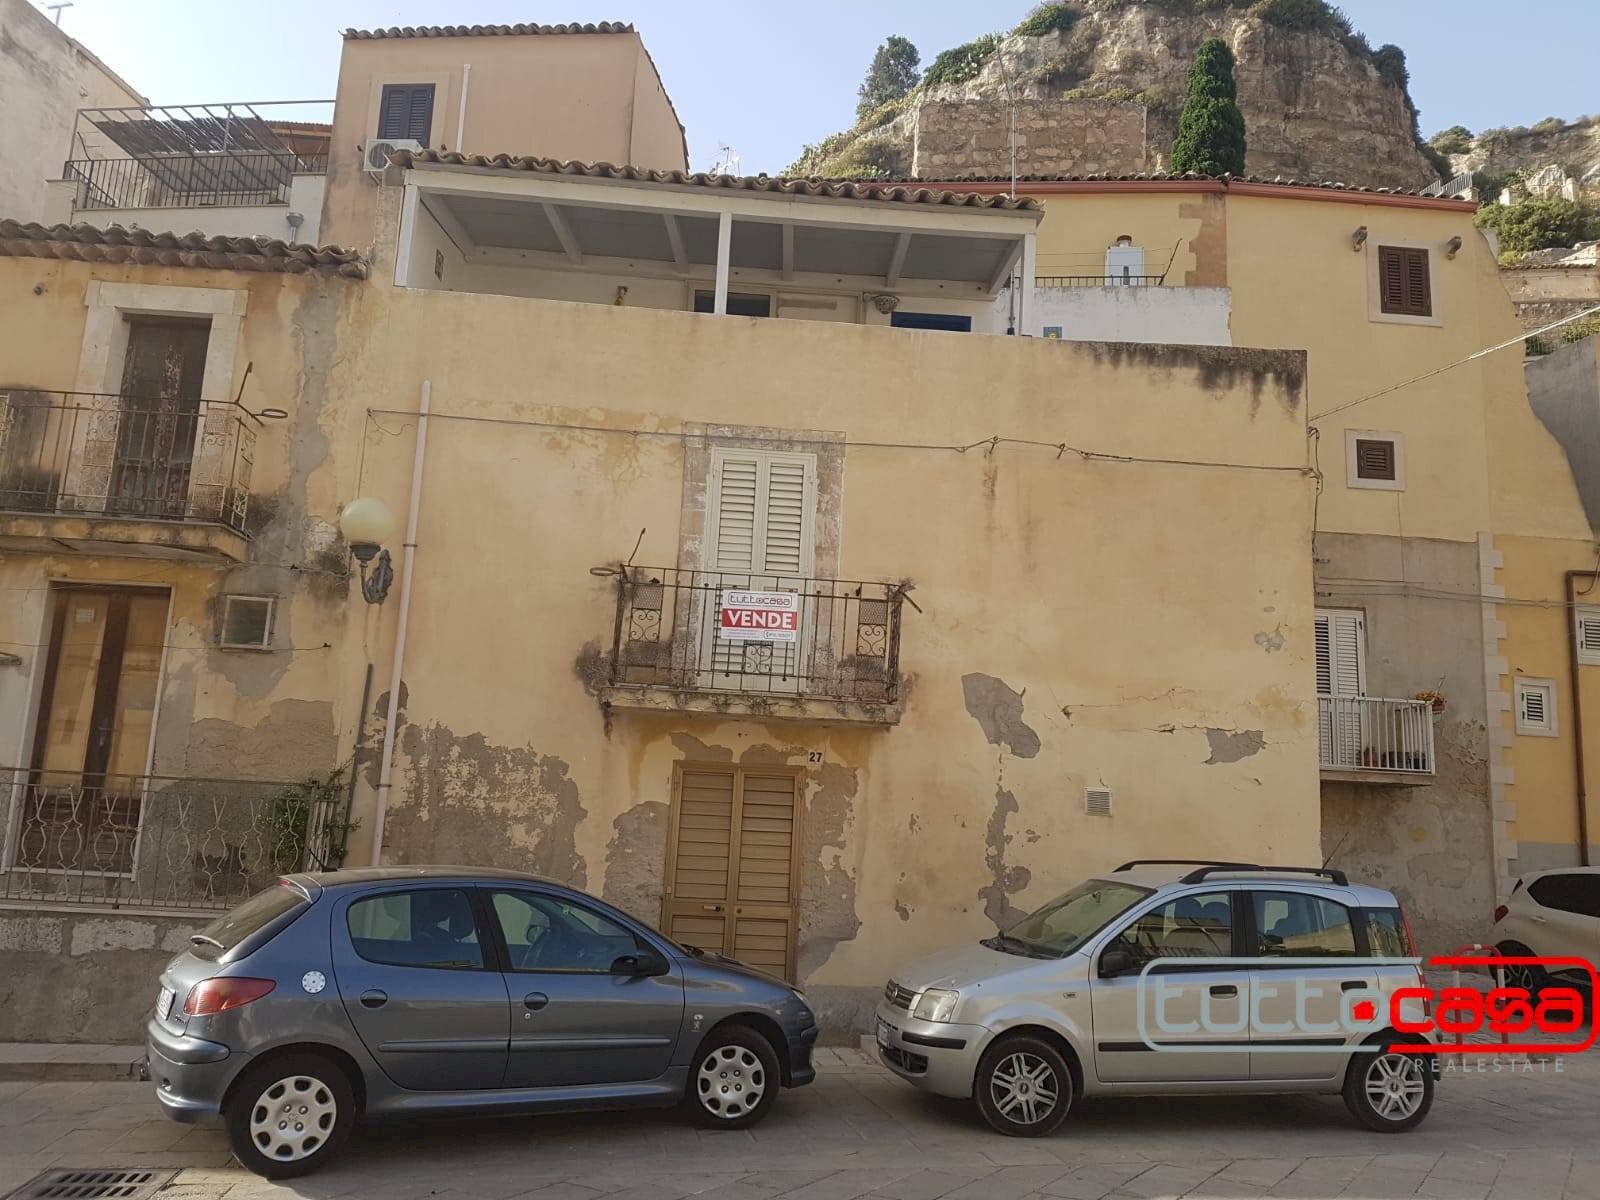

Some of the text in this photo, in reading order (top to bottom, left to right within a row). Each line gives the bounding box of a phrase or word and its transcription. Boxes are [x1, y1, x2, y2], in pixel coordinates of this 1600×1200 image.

[730, 594, 791, 606] tuttocasa
[728, 610, 792, 628] VENDE
[809, 752, 822, 762] 27
